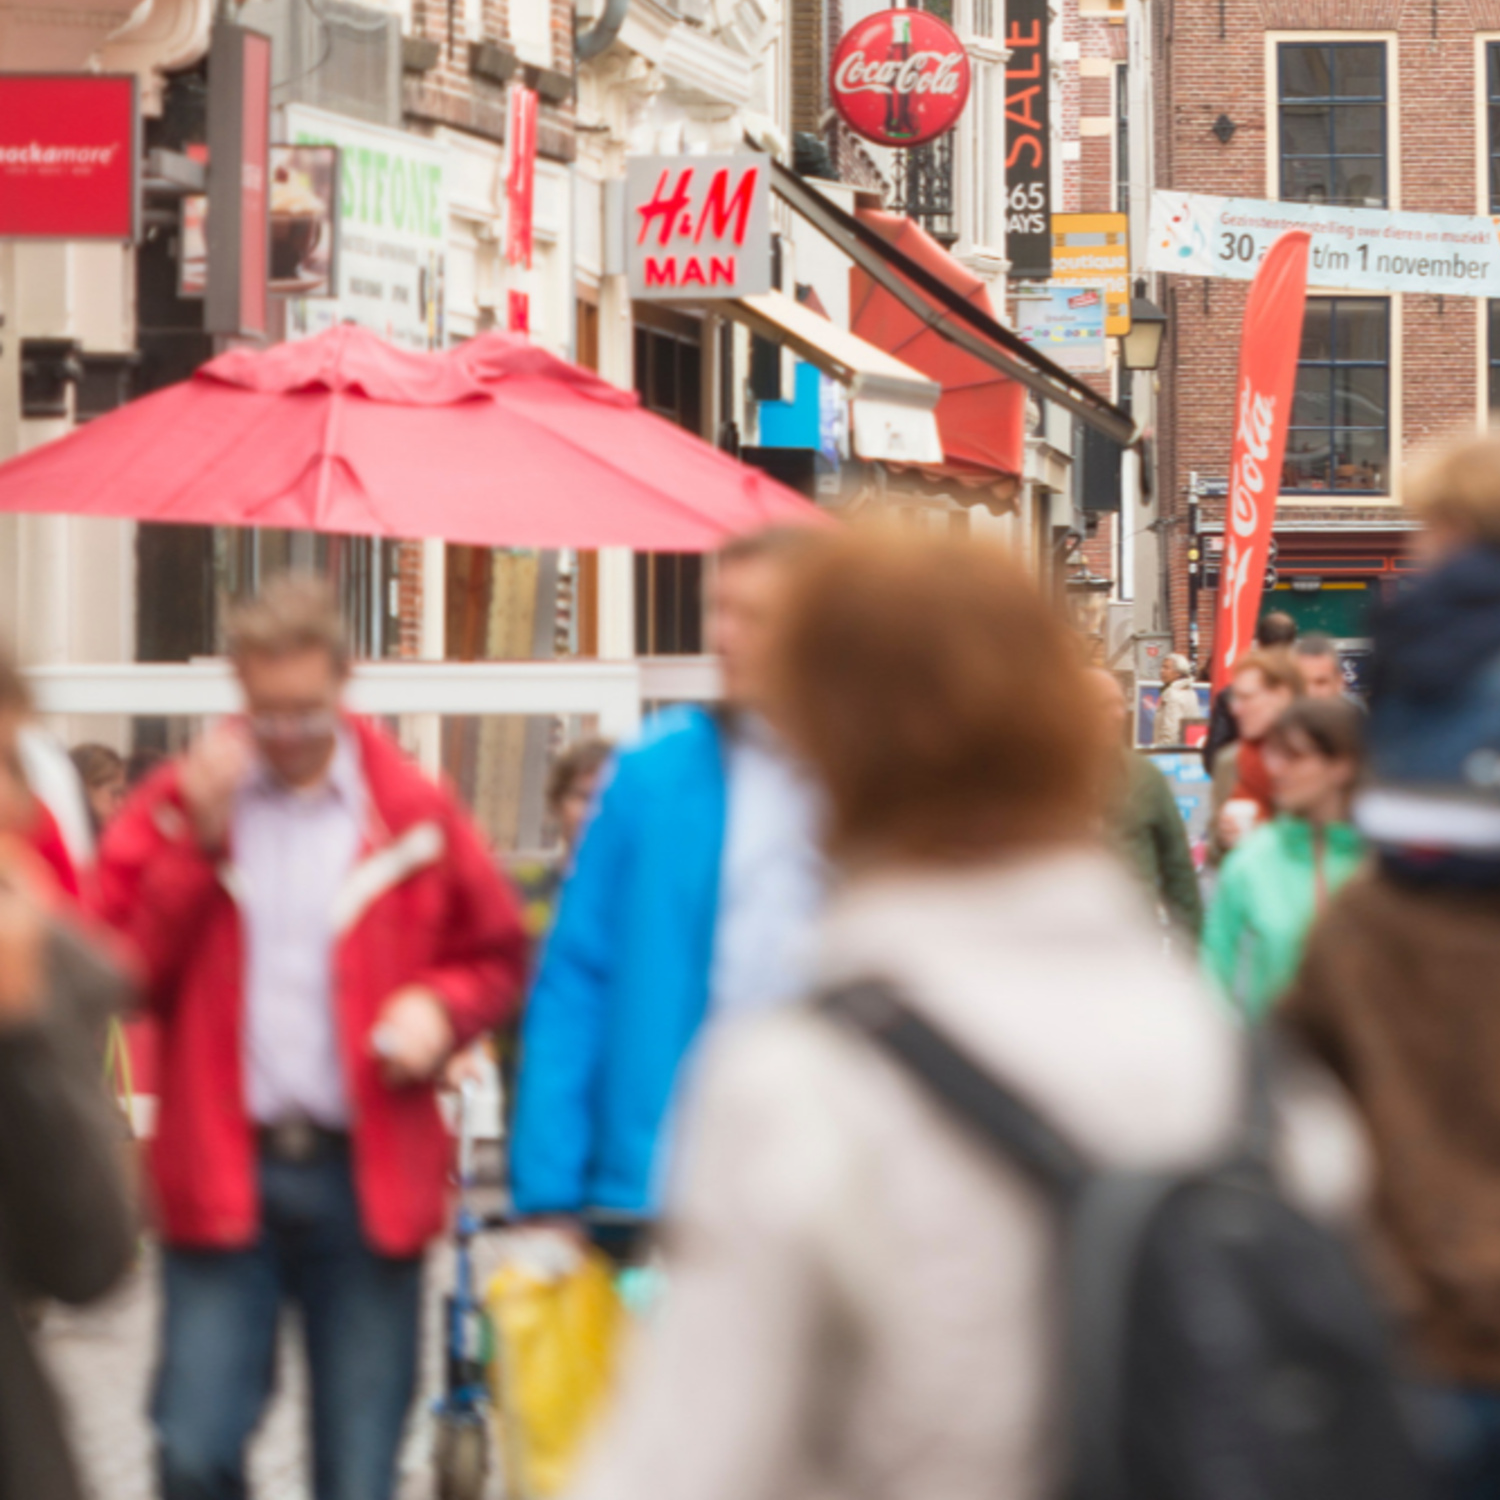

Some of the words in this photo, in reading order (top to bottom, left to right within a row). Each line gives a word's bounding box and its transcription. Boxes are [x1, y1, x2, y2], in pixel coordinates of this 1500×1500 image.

[834, 51, 965, 94] Coca-Cola
[1005, 18, 1043, 169] SALE
[636, 166, 759, 247] H&M
[1006, 183, 1045, 211] 65
[1007, 213, 1046, 234] AYS
[645, 256, 735, 287] MAN
[1218, 232, 1254, 262] 30
[1313, 244, 1349, 270] t/m
[1357, 243, 1369, 272] 1
[1377, 252, 1490, 280] november
